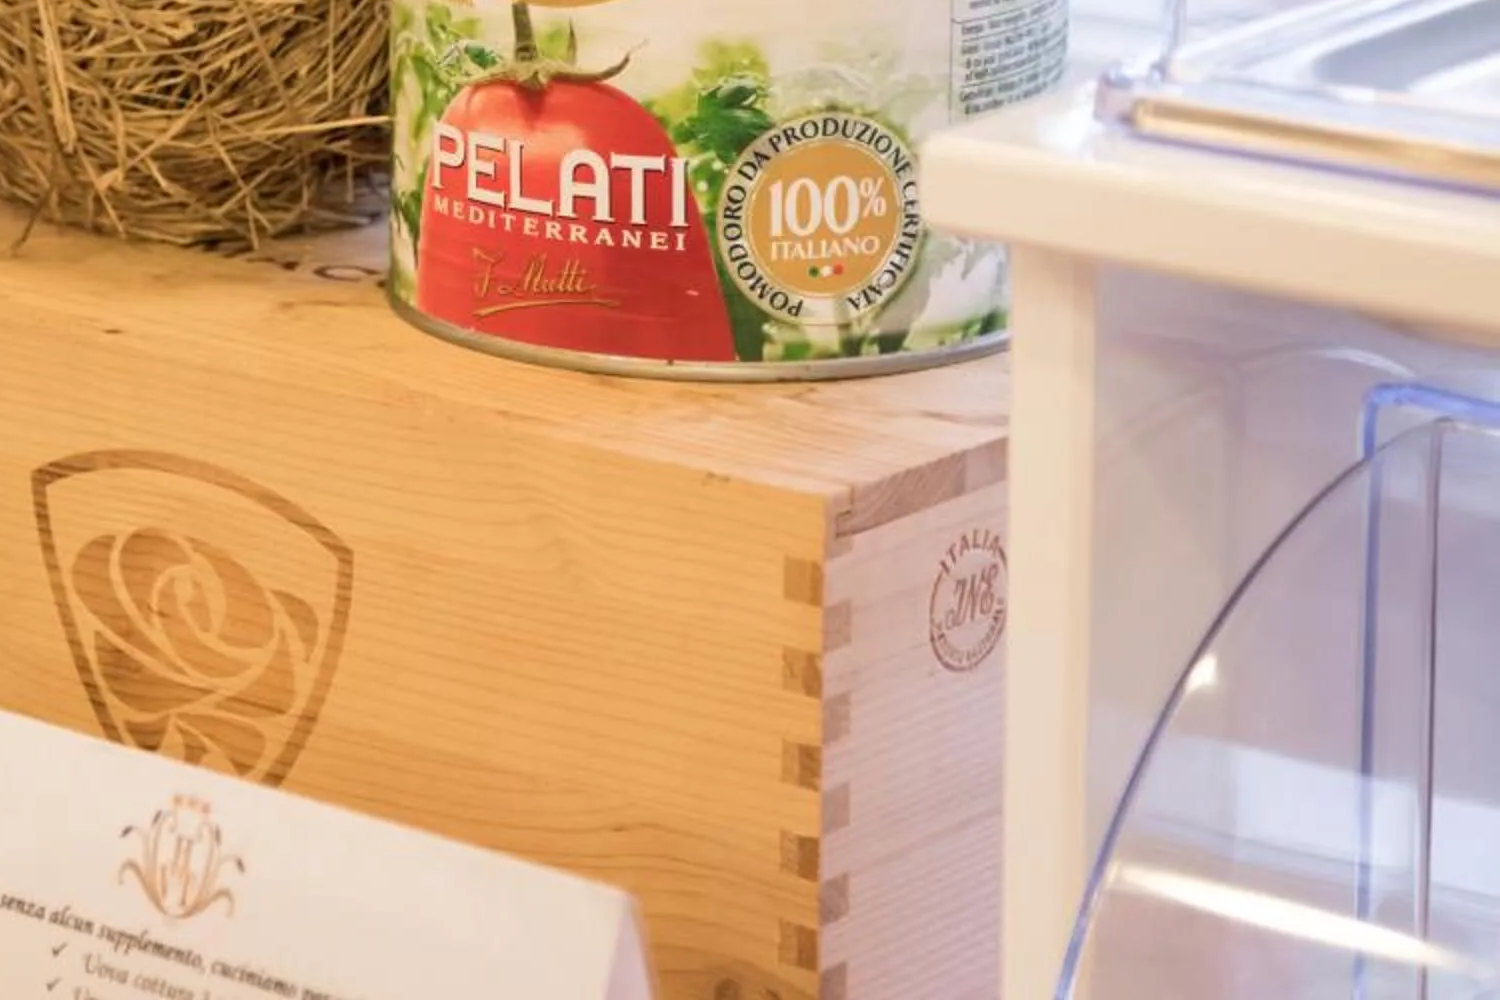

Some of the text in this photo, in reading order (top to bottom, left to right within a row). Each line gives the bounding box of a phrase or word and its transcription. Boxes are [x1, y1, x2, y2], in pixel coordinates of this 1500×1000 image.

[432, 120, 691, 227] PELATI
[738, 150, 772, 182] DA
[768, 117, 914, 180] PRODUZIONE
[434, 195, 687, 251] MEDITERRANEI
[769, 175, 888, 237] 100%
[723, 185, 804, 317] POMODORO
[771, 235, 882, 261] ITALIANO
[939, 528, 1002, 574] ITALIA
[0, 893, 46, 921] senza
[49, 906, 95, 936] alcun
[98, 923, 206, 975] supplemento,
